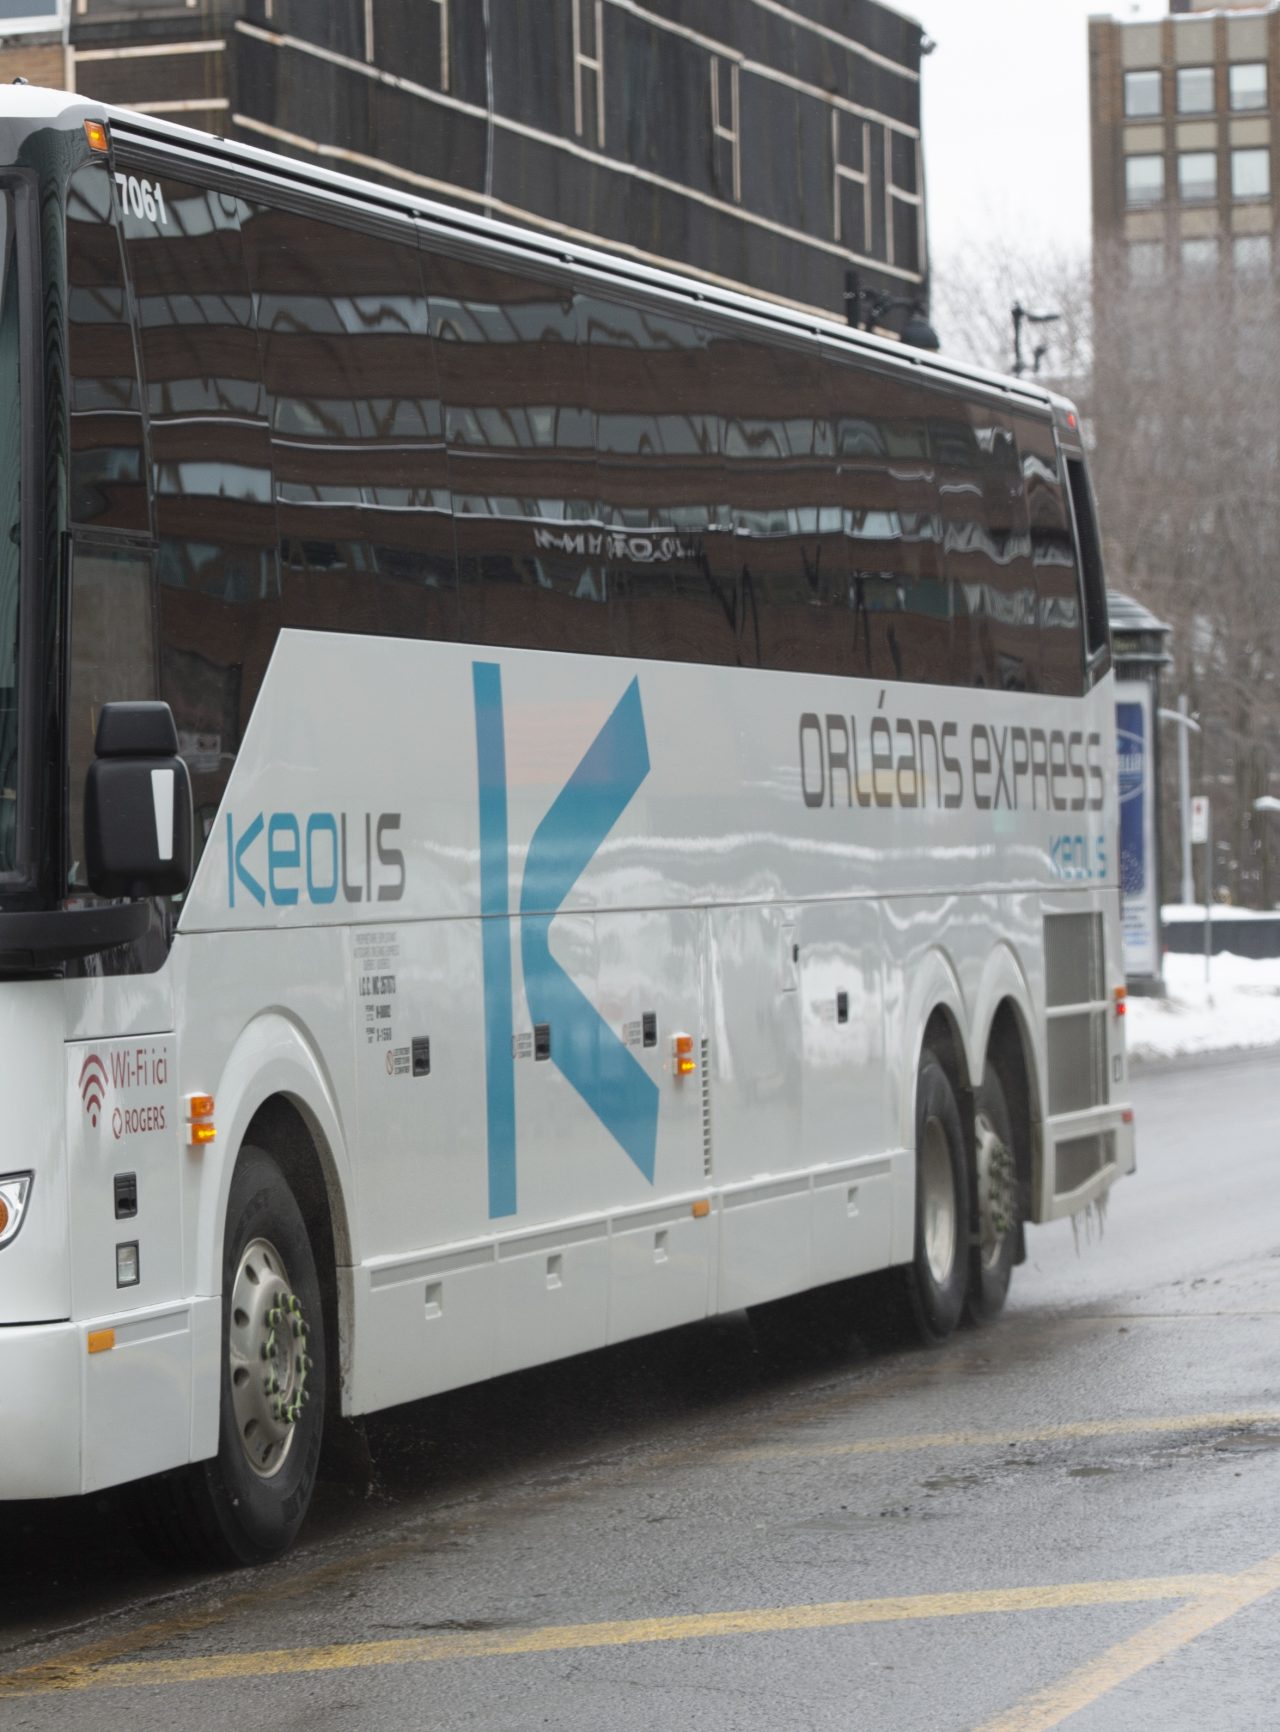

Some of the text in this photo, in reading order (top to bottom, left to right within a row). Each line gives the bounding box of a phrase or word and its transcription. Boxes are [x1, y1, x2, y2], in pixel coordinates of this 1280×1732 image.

[114, 173, 168, 225] 7061
[110, 1046, 168, 1089] Wi-Fi ici
[124, 1105, 166, 1134] ROGERS
